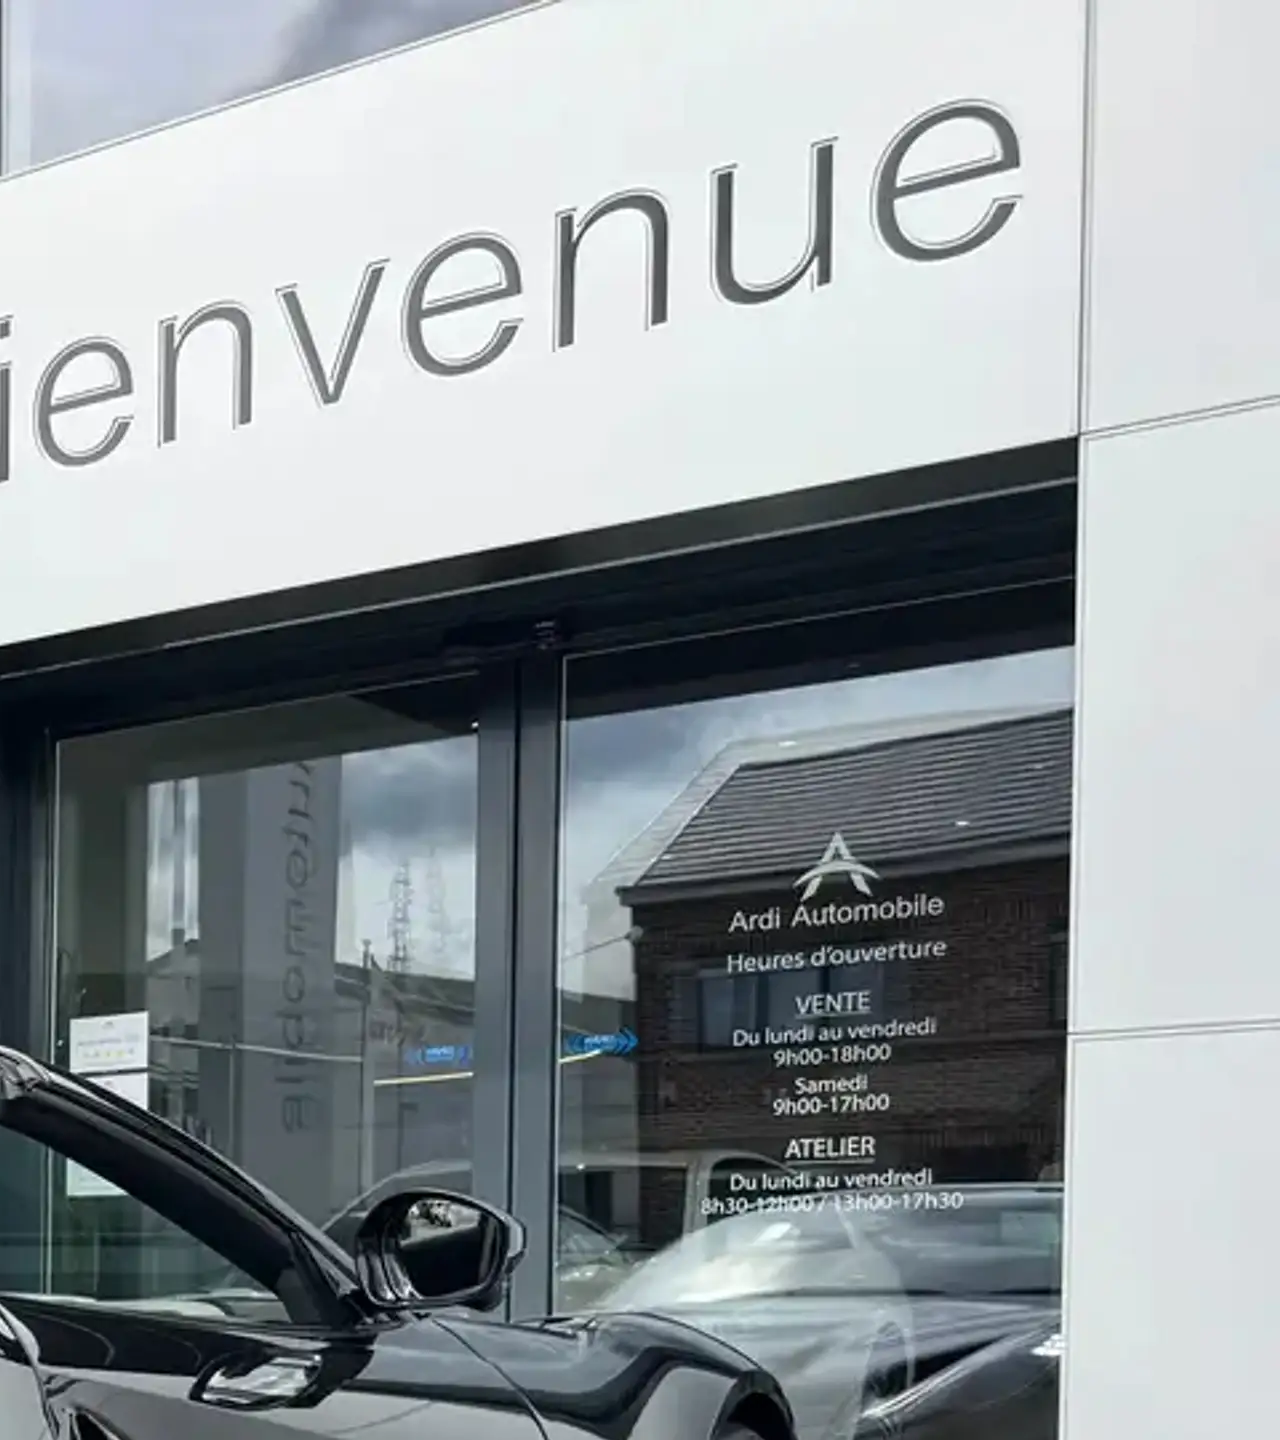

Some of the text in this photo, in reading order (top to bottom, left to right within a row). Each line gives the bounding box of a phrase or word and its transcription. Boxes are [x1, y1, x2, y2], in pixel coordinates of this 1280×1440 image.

[728, 895, 945, 933] Ardi Automobile
[726, 940, 948, 974] Heures d'ouverture
[795, 990, 872, 1014] VENTE
[732, 1016, 937, 1047] Du lundi au vendredi
[773, 1044, 892, 1067] 9h00-18h00
[794, 1074, 869, 1096] Samedi
[772, 1094, 890, 1117] 9h00-17h00
[785, 1135, 876, 1160] ATELIER
[730, 1166, 933, 1192] Du lundi au vendredi
